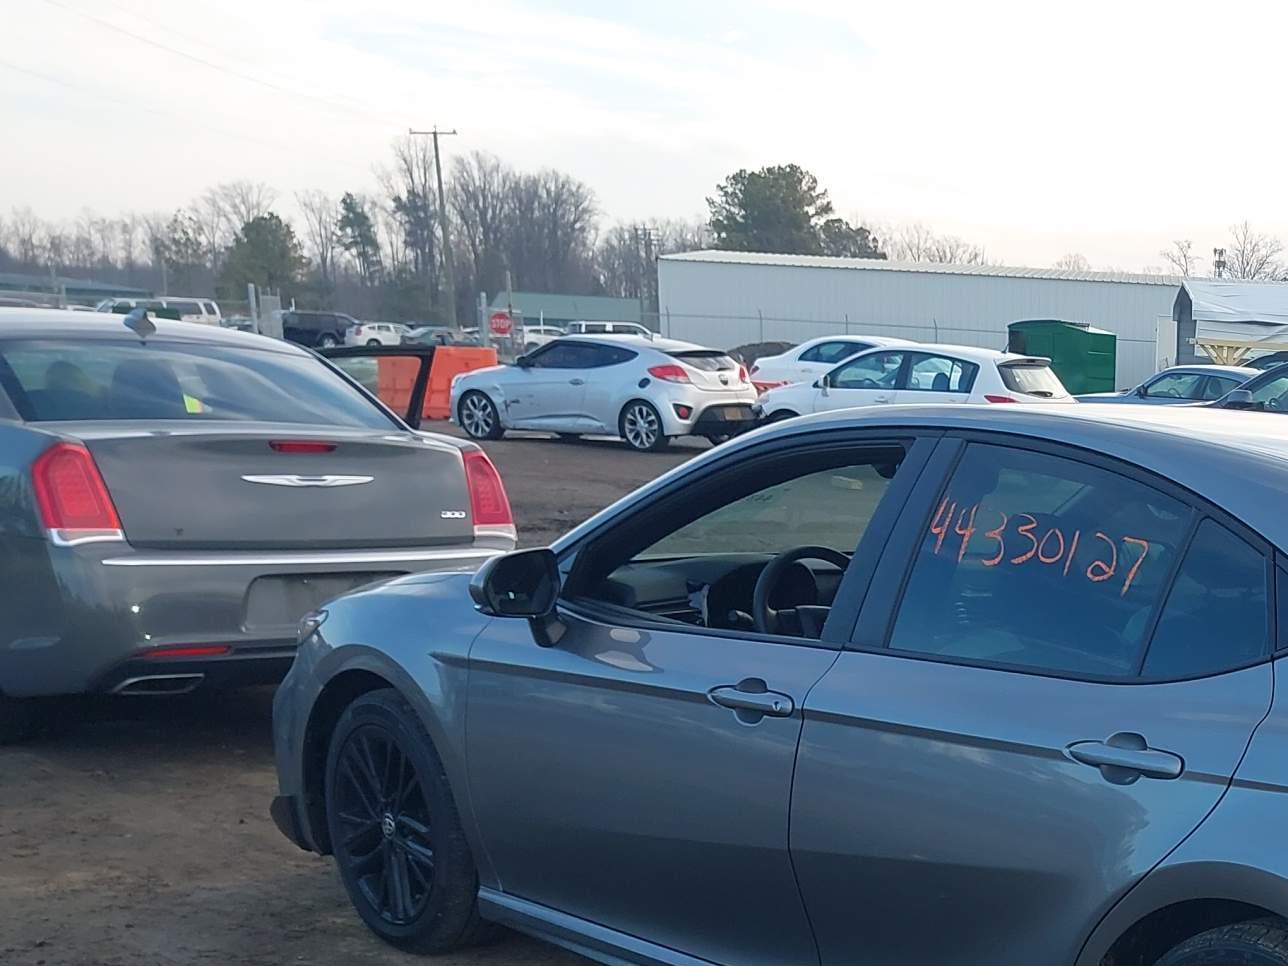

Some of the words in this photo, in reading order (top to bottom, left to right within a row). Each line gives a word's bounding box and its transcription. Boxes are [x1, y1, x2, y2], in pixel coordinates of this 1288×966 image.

[491, 318, 511, 329] STOP
[441, 510, 466, 518] 300
[930, 495, 1149, 597] 44330127
